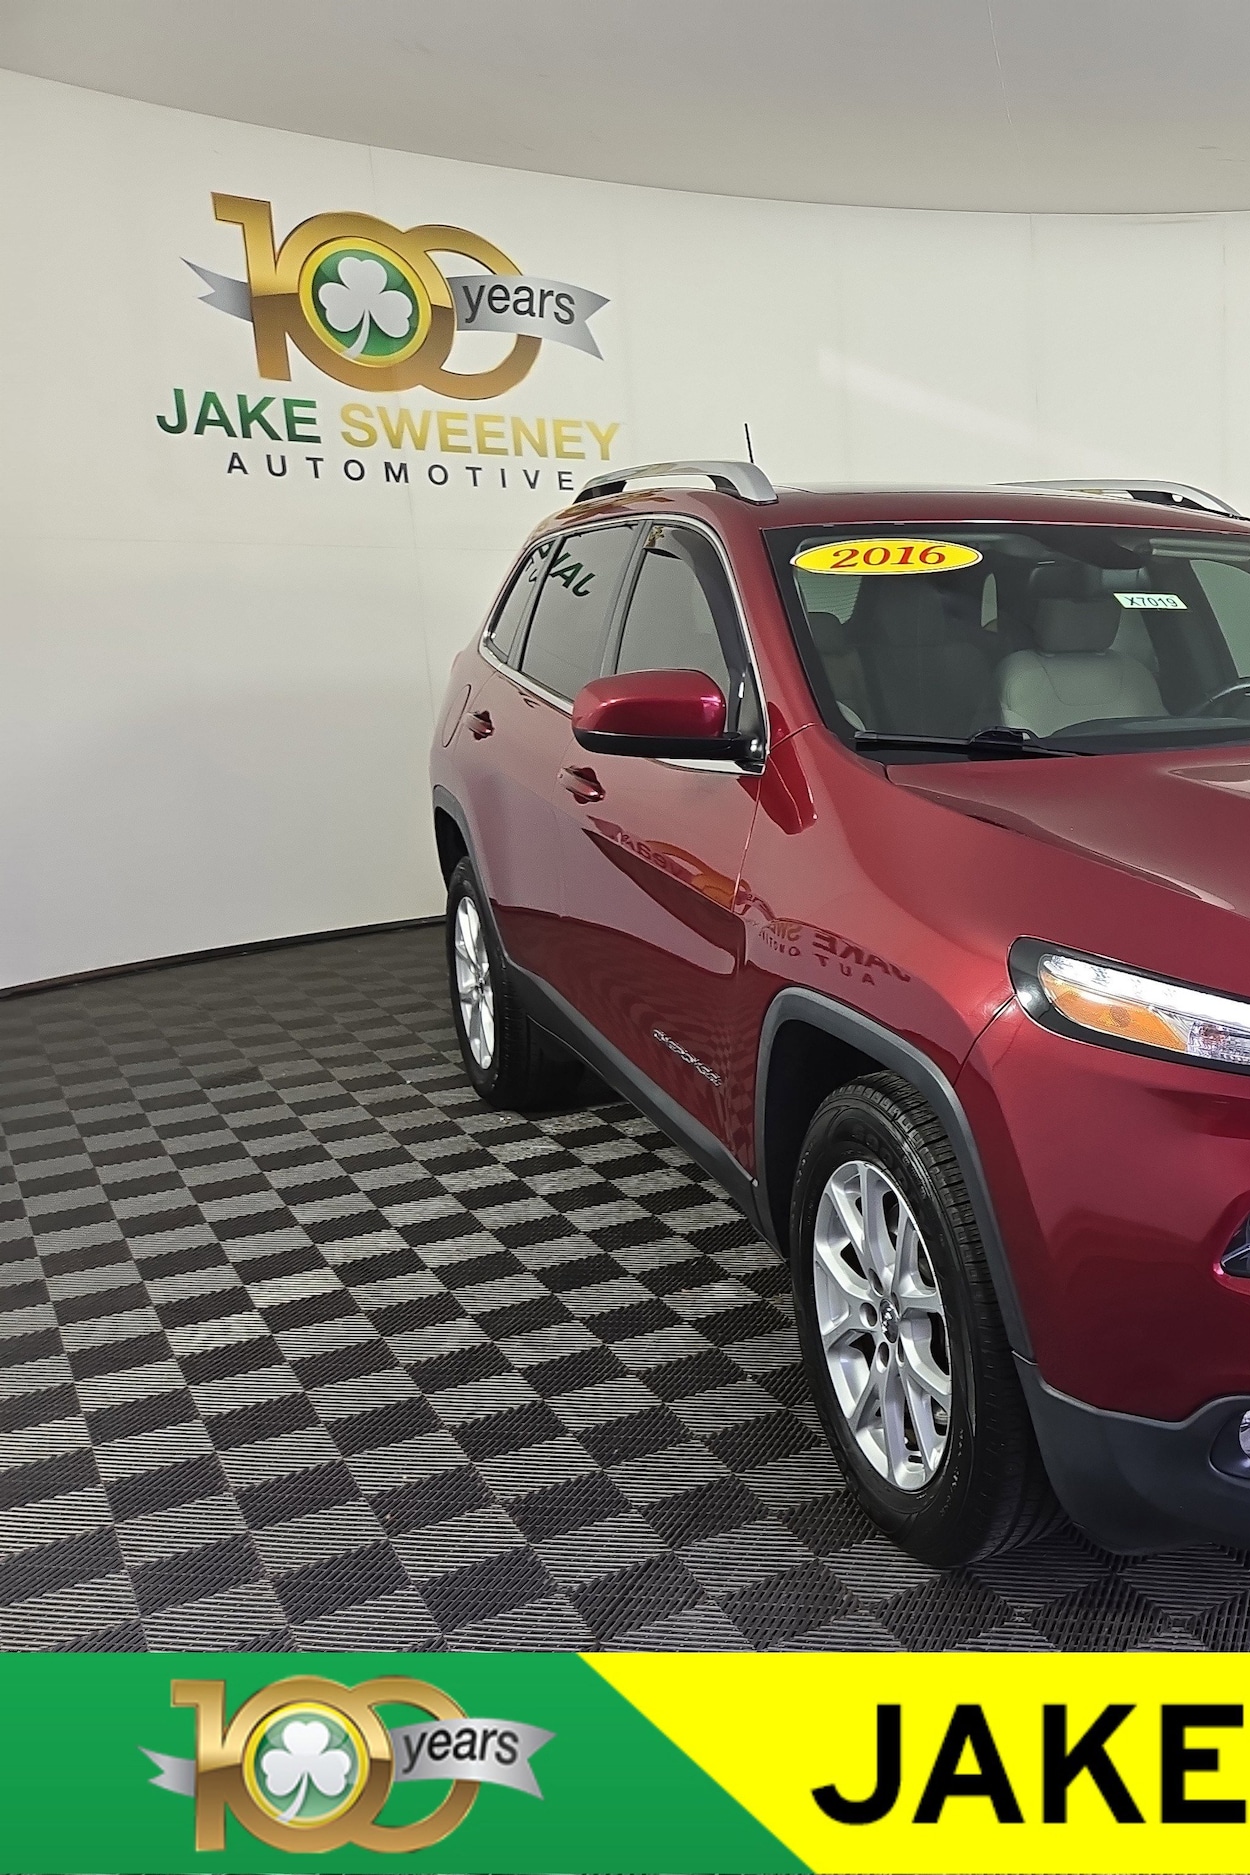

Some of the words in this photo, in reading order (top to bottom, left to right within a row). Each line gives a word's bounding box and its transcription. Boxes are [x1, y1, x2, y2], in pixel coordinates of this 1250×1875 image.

[211, 191, 542, 401] 100
[462, 284, 577, 326] years
[156, 388, 322, 444] JAKE
[340, 402, 621, 462] SWEENEY
[227, 452, 575, 492] AUTOMOTIVE
[830, 545, 947, 569] 2016
[1123, 596, 1178, 608] X7019
